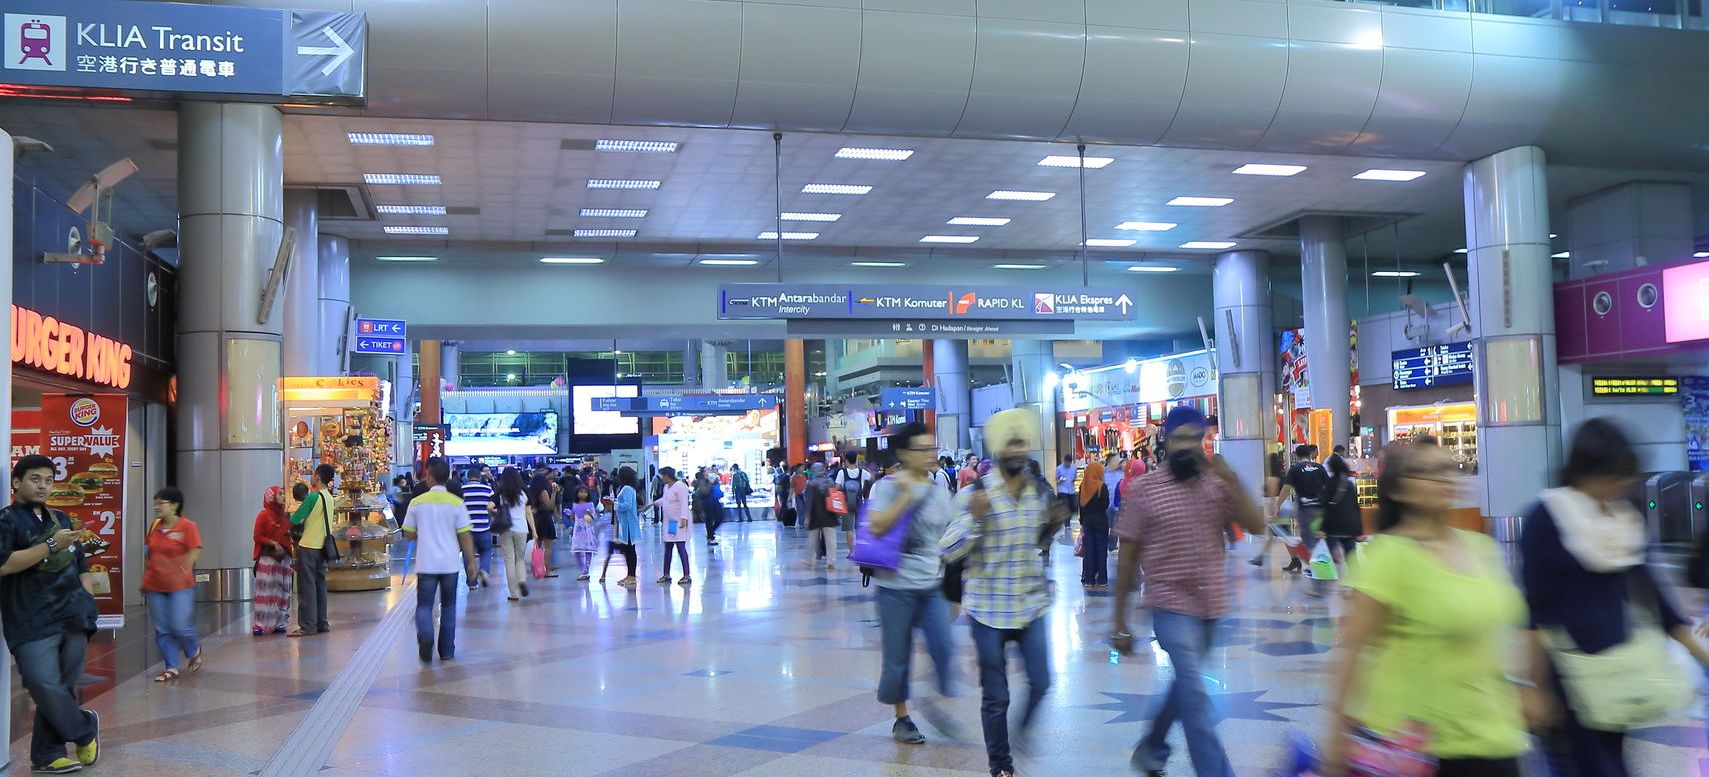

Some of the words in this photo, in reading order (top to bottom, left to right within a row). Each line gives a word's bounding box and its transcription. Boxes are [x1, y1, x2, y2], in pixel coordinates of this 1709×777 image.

[76, 22, 147, 49] KLIA
[151, 26, 244, 53] Transit
[76, 55, 235, 78] 空港行き普通電車
[751, 296, 778, 308] KTM
[778, 292, 847, 303] Antarabandar
[876, 297, 902, 308] KTM
[904, 297, 948, 308] Komuter
[978, 298, 1009, 308] RAPID
[1011, 298, 1025, 308] KL
[1055, 294, 1078, 304] KLIA
[1080, 294, 1113, 307] Ekspres
[778, 304, 811, 315] Intercity
[374, 324, 389, 332] LRT
[371, 341, 392, 349] TIKET
[86, 331, 132, 389] KING
[316, 378, 364, 387] Ckies
[74, 402, 97, 414] BURGER
[74, 408, 97, 420] KING
[50, 435, 85, 447] SUPER
[84, 435, 118, 447] VALUE
[99, 510, 116, 535] 2
